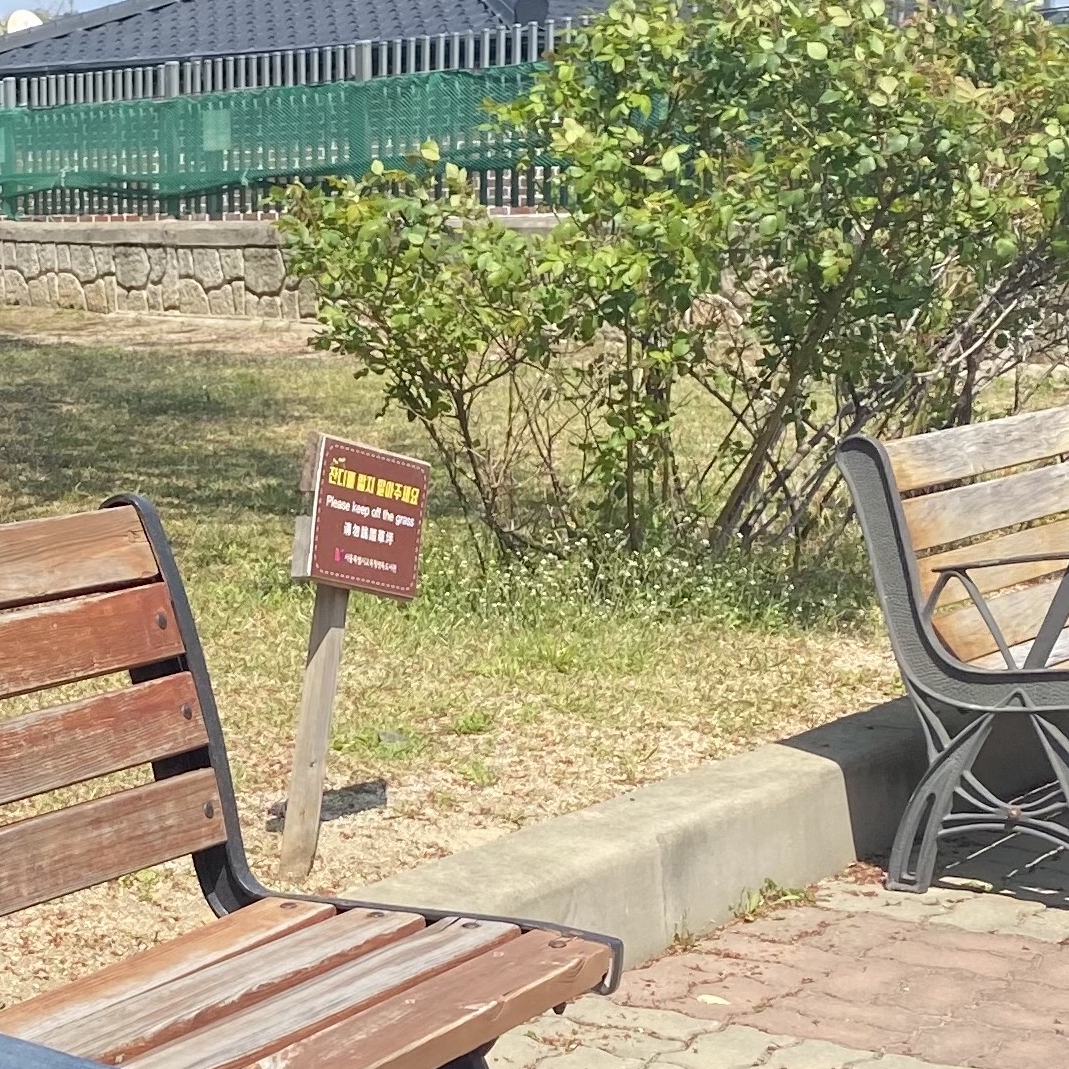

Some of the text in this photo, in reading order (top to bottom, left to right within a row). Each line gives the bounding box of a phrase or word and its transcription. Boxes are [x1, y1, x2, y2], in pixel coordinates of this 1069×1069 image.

[326, 494, 416, 528] Please keep off the grass
